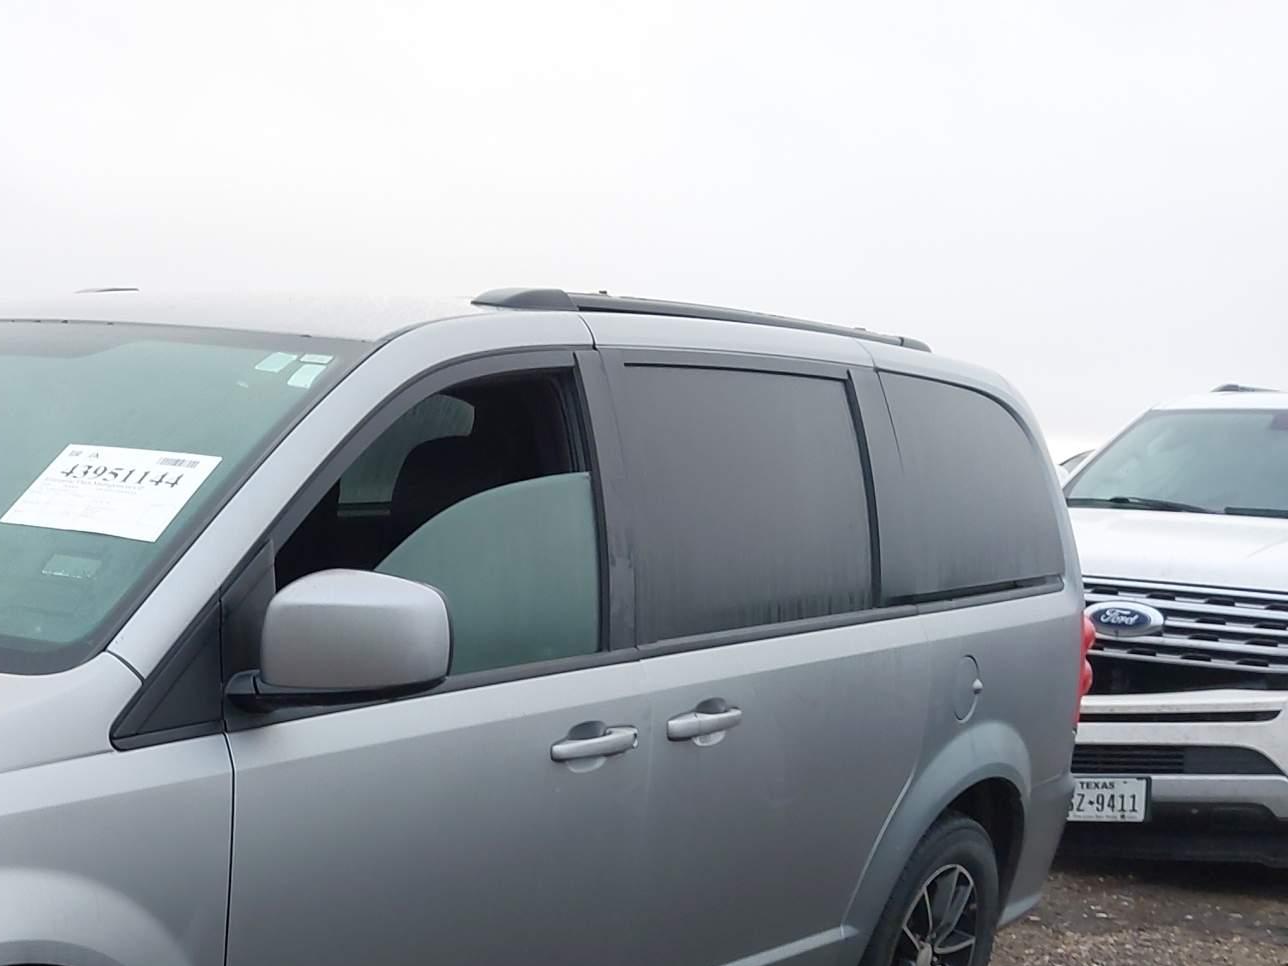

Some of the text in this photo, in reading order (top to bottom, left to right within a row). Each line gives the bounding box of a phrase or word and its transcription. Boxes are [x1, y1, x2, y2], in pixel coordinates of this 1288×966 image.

[60, 463, 185, 489] 43951144
[1100, 608, 1139, 625] Ford
[1079, 781, 1115, 790] TEXAS
